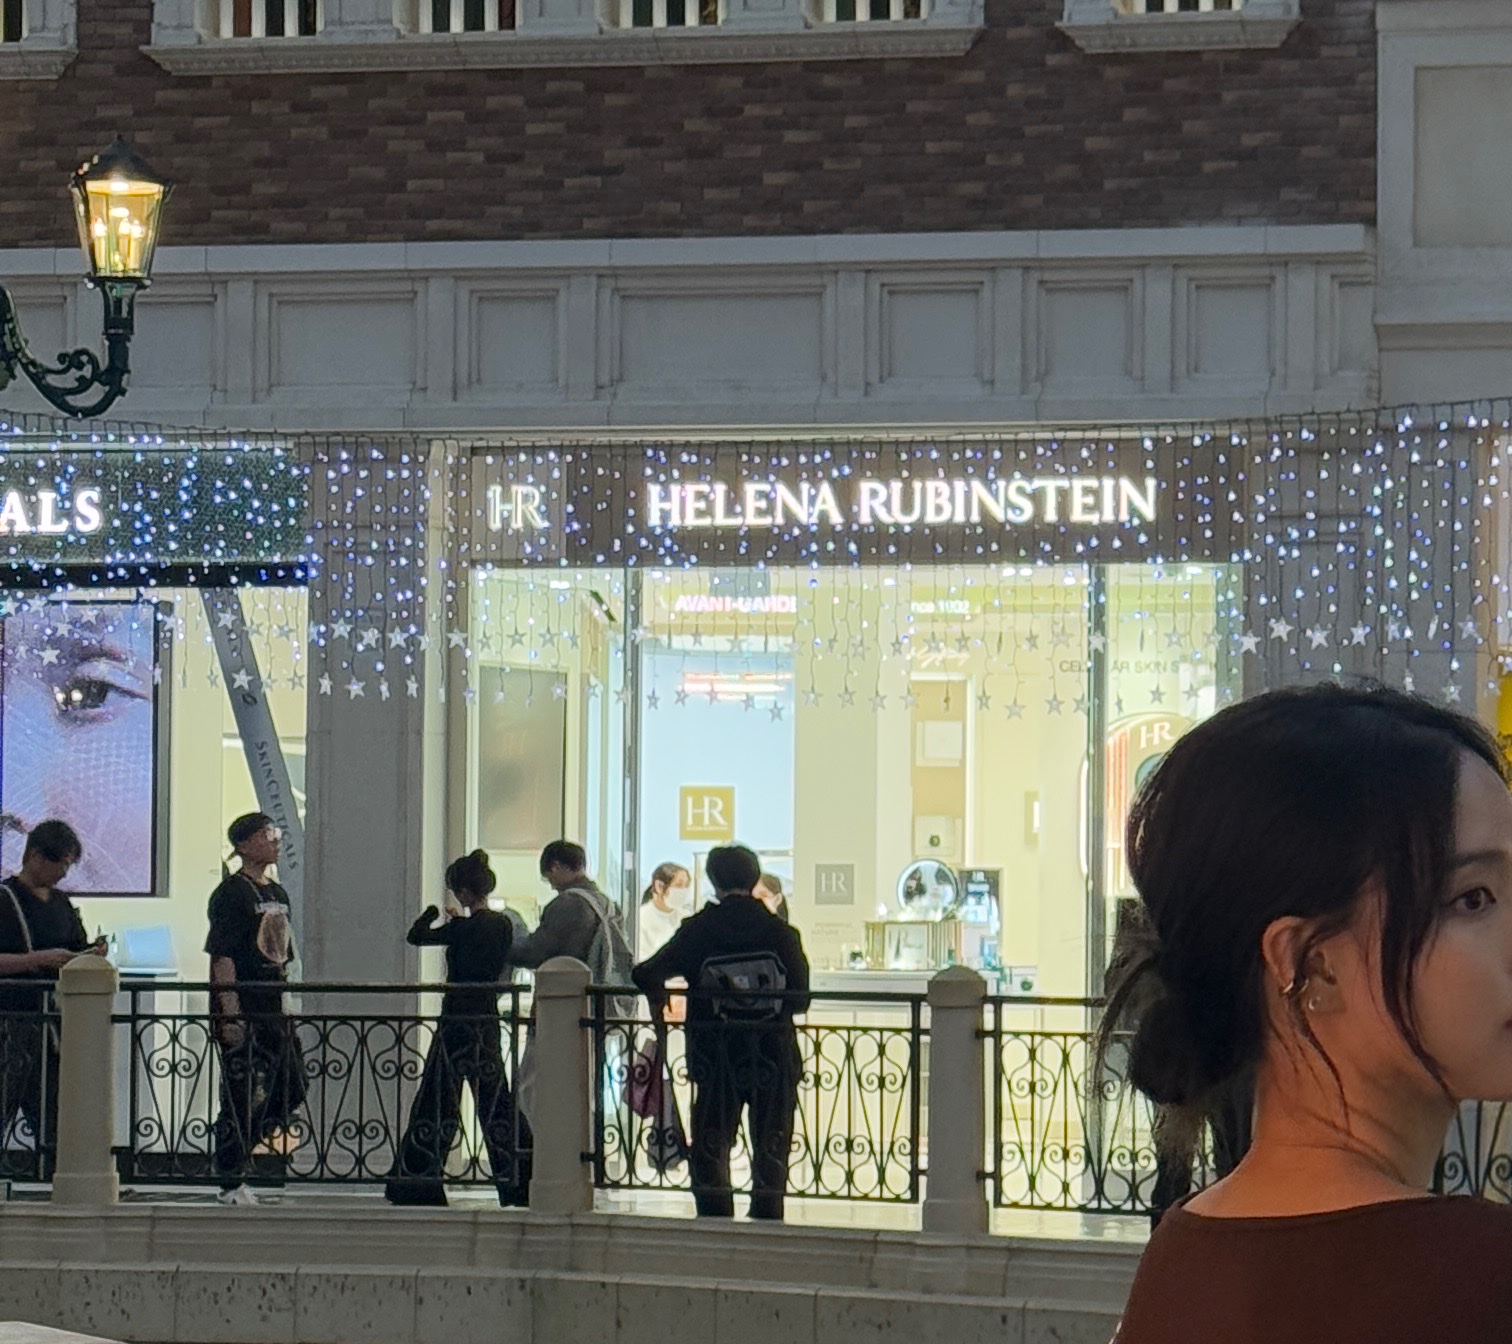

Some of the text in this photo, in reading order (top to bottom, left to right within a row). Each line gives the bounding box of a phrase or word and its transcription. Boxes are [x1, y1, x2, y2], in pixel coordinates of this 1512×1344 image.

[0, 490, 102, 533] ALS
[488, 485, 547, 530] HR
[647, 477, 1156, 527] HELENA RUBINSTEIN
[1140, 722, 1175, 748] HR
[686, 795, 728, 827] HR
[821, 871, 847, 893] HR
